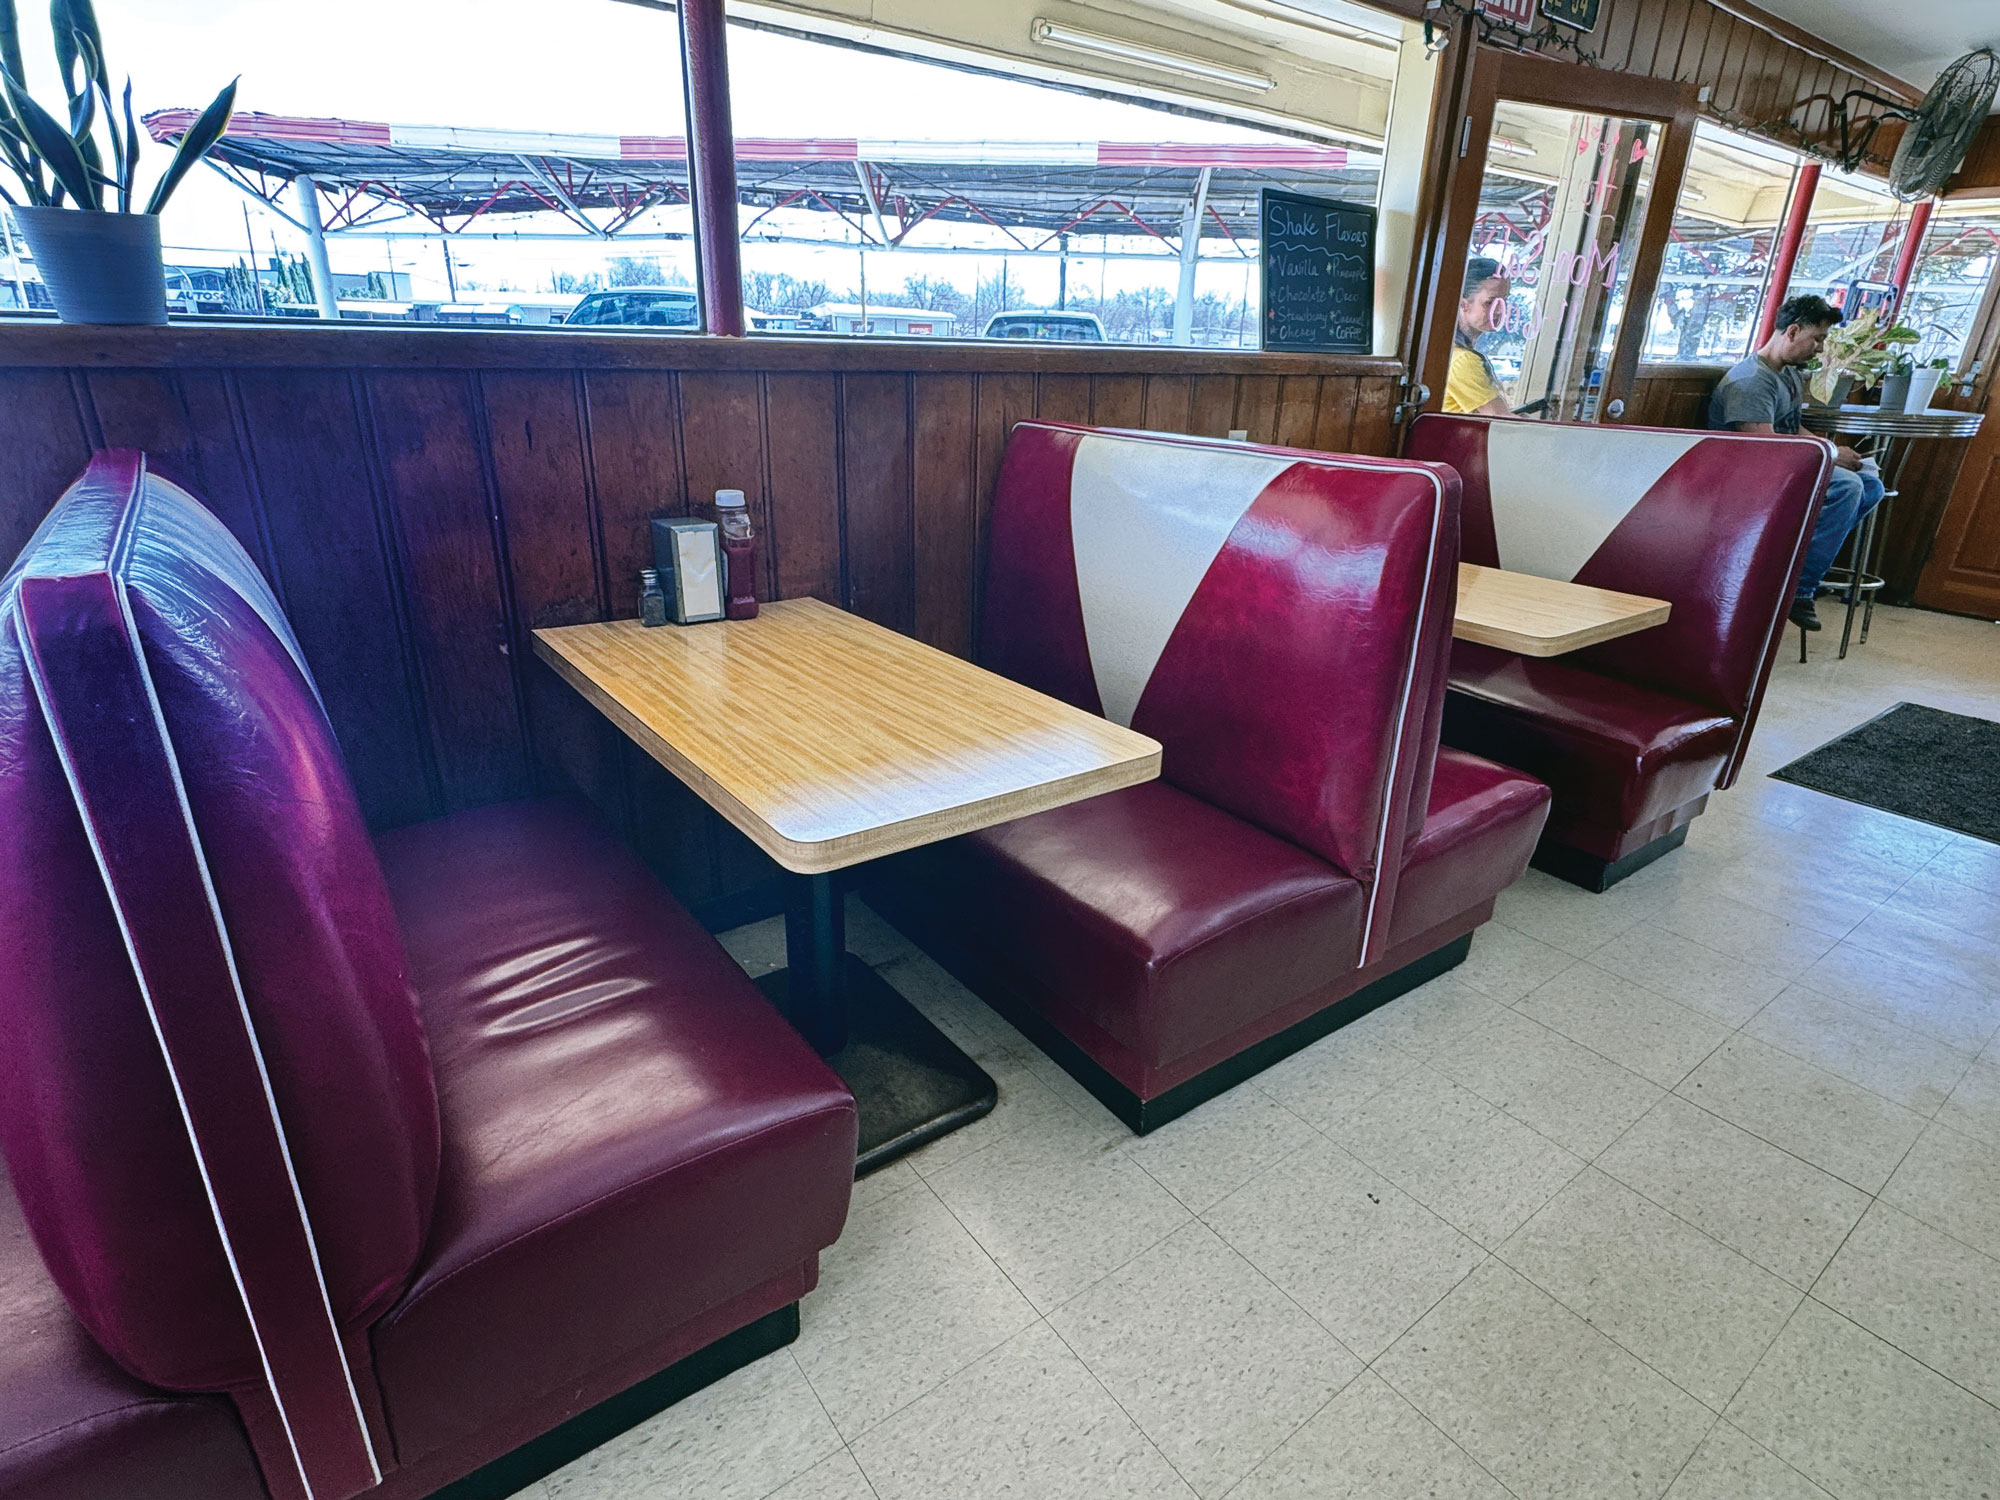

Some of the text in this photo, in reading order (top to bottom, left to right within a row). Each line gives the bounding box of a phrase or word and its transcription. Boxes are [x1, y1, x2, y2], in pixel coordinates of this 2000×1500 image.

[1269, 205, 1368, 247] Shake Flavors
[1277, 255, 1319, 276] Vanilla
[1277, 285, 1327, 303] Chocolate
[1280, 325, 1317, 341] Cherry
